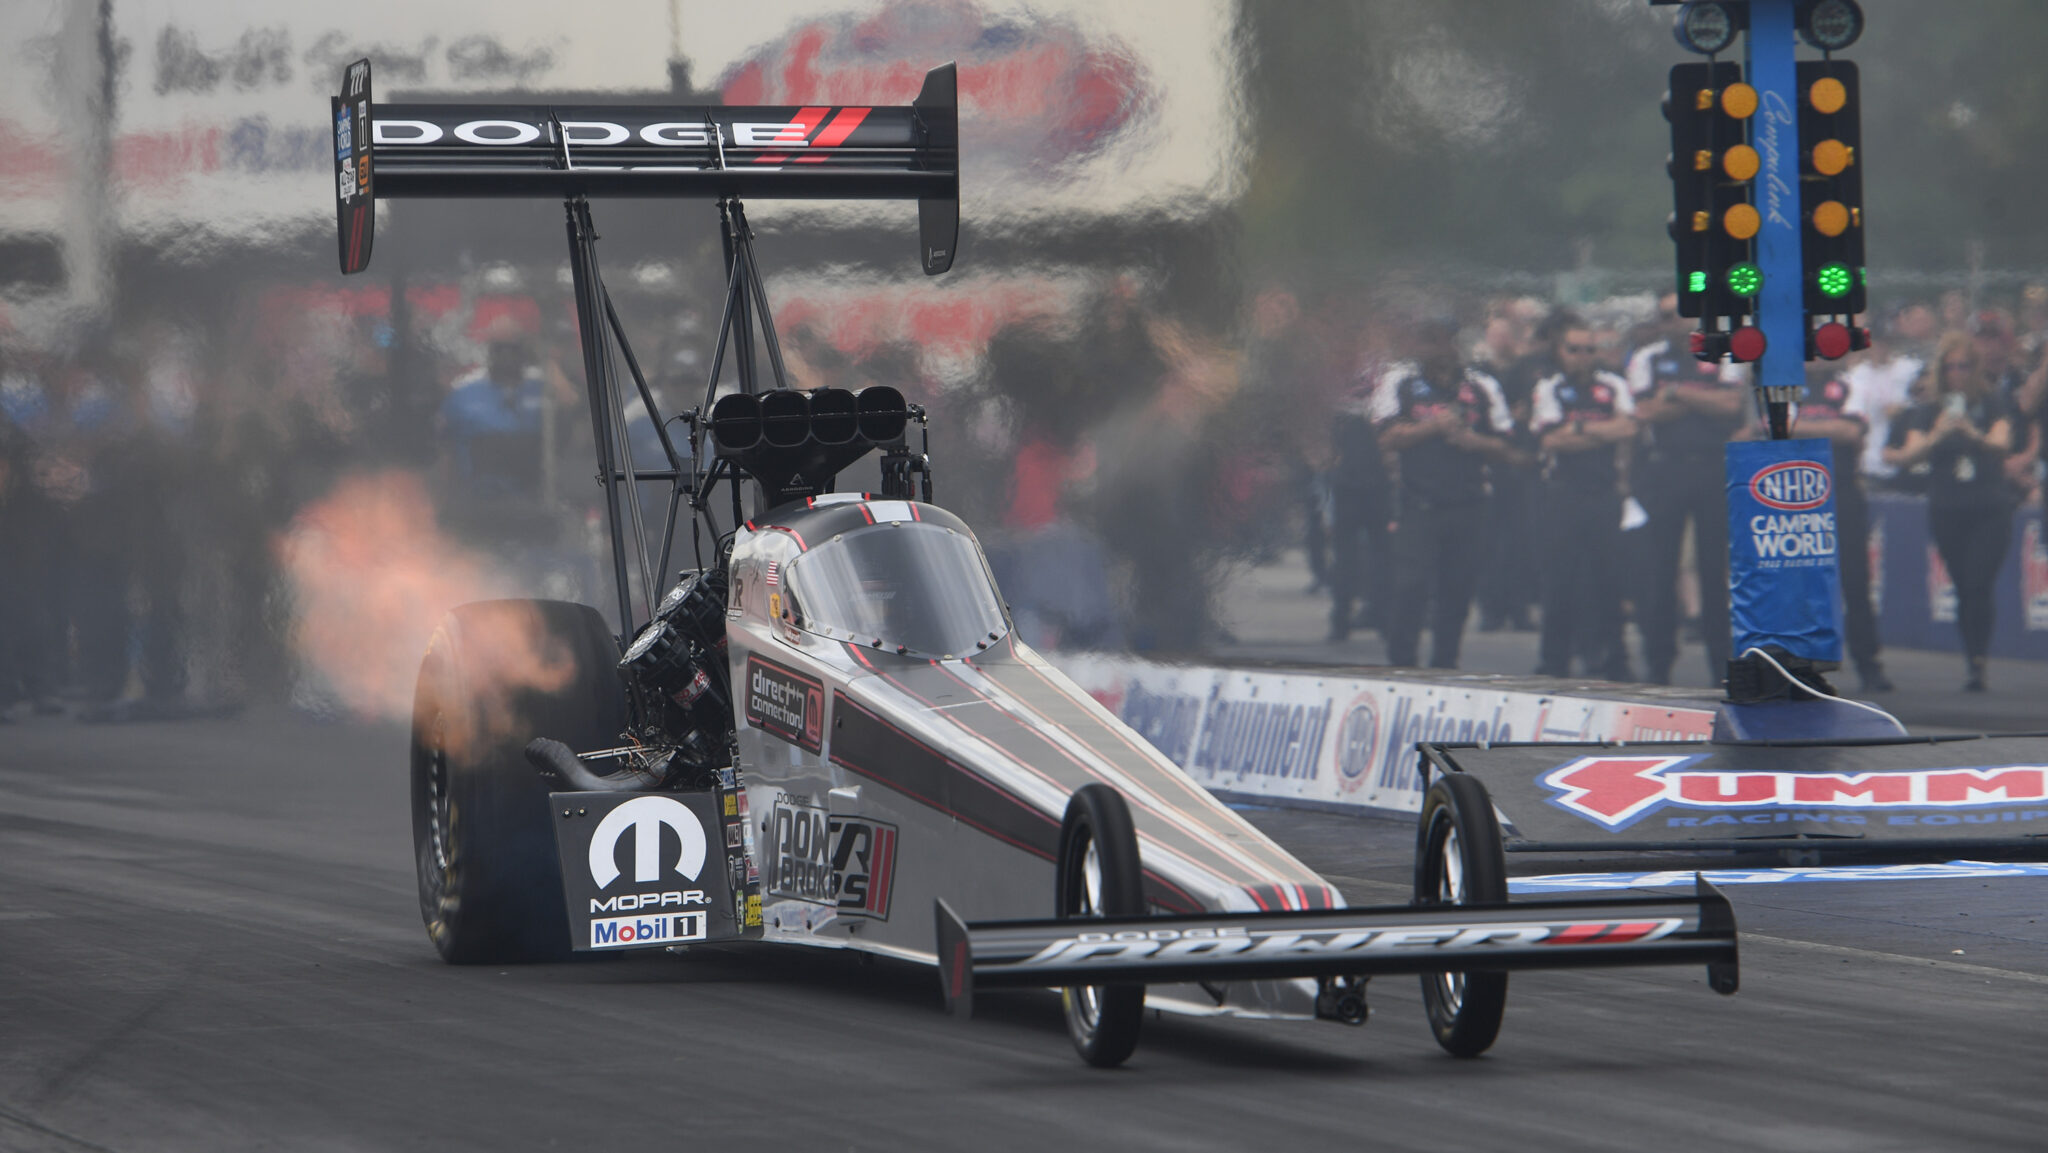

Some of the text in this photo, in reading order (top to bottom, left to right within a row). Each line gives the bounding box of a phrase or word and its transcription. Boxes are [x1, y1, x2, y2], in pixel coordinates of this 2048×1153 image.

[372, 119, 809, 147] DODGE
[1757, 89, 1793, 230] Compulink
[1763, 468, 1828, 502] NHRA
[1750, 512, 1835, 535] CAMPING
[1752, 532, 1836, 558] WORLD
[752, 668, 794, 706] direct
[752, 694, 803, 730] connection
[1194, 683, 1333, 782] Equipment
[1667, 812, 1867, 828] RACING
[595, 917, 667, 944] Mobil
[1078, 926, 1248, 943] DODGE
